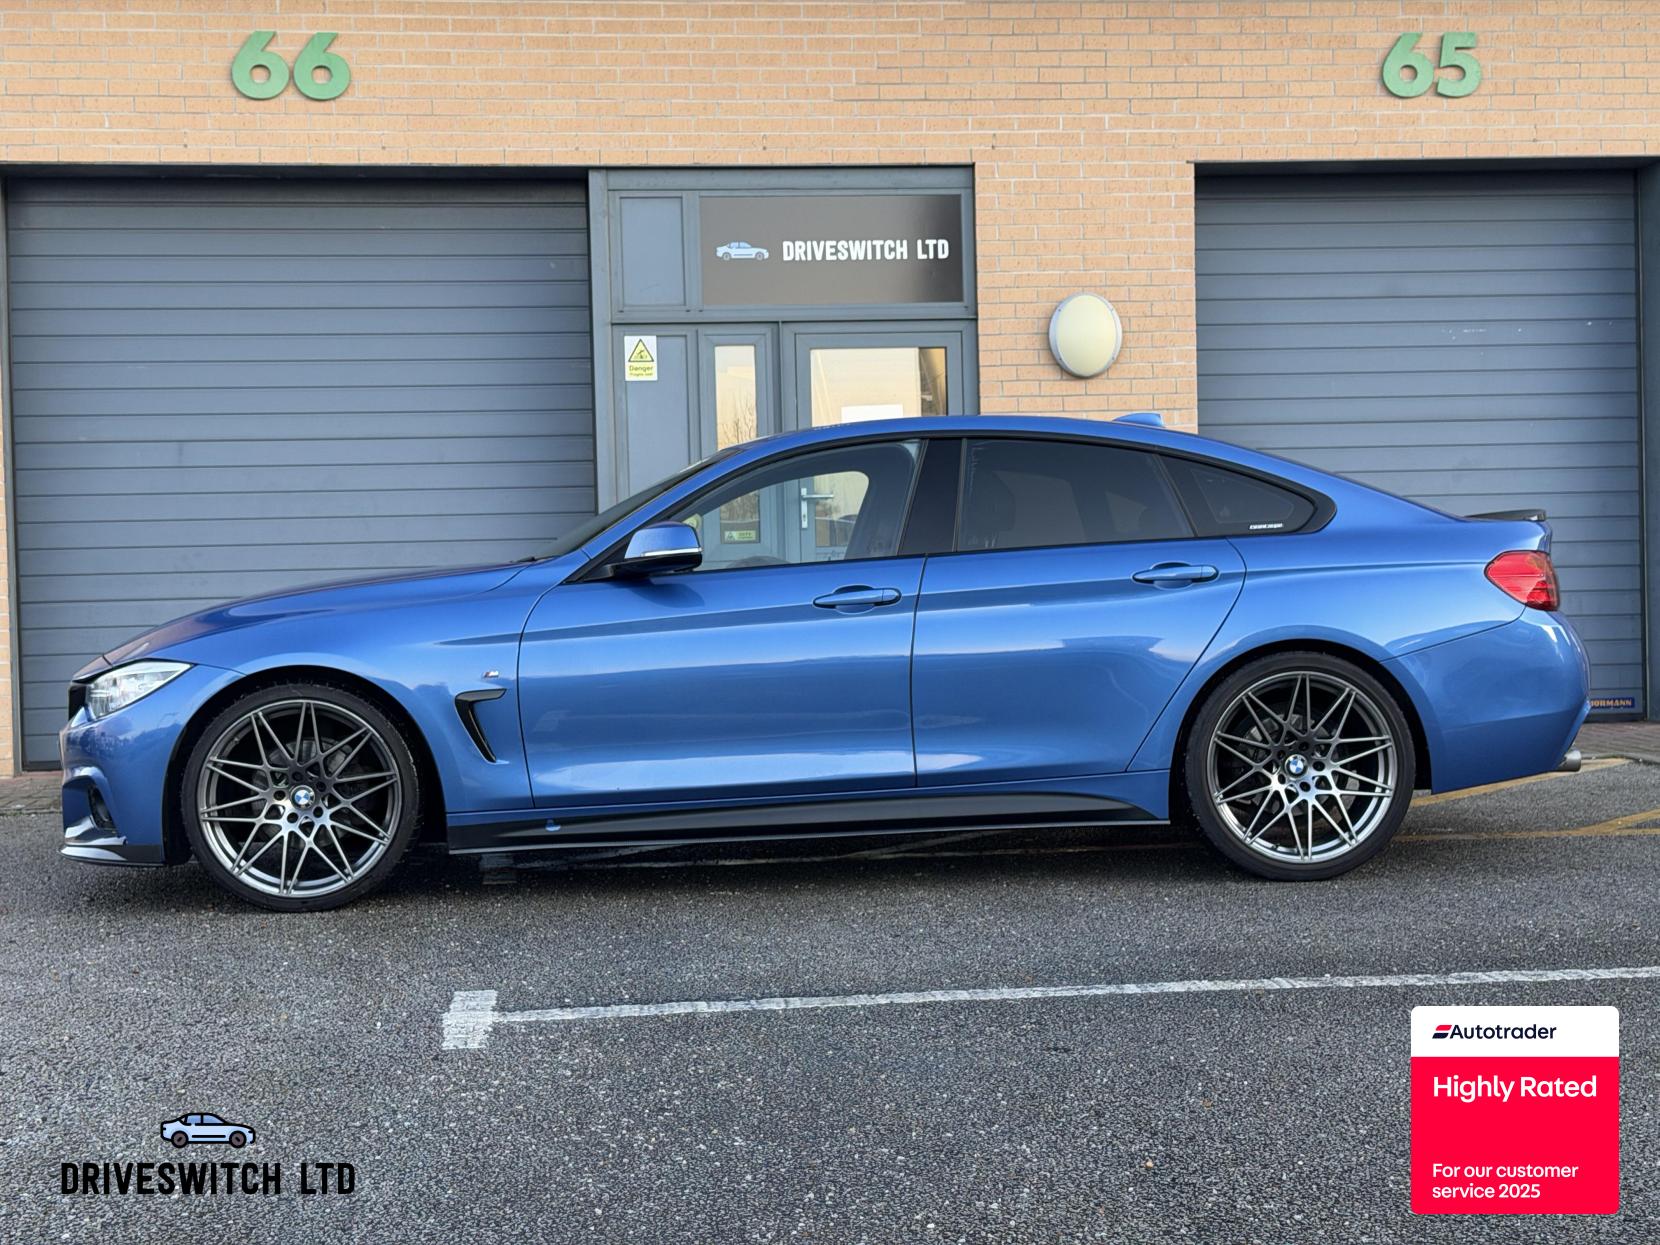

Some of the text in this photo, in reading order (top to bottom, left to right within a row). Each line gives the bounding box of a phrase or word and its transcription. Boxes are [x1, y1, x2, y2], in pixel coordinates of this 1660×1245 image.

[231, 30, 351, 101] 66
[1381, 31, 1482, 98] 65
[782, 239, 949, 261] DRIVESWITCH LTD
[628, 365, 654, 373] Danger
